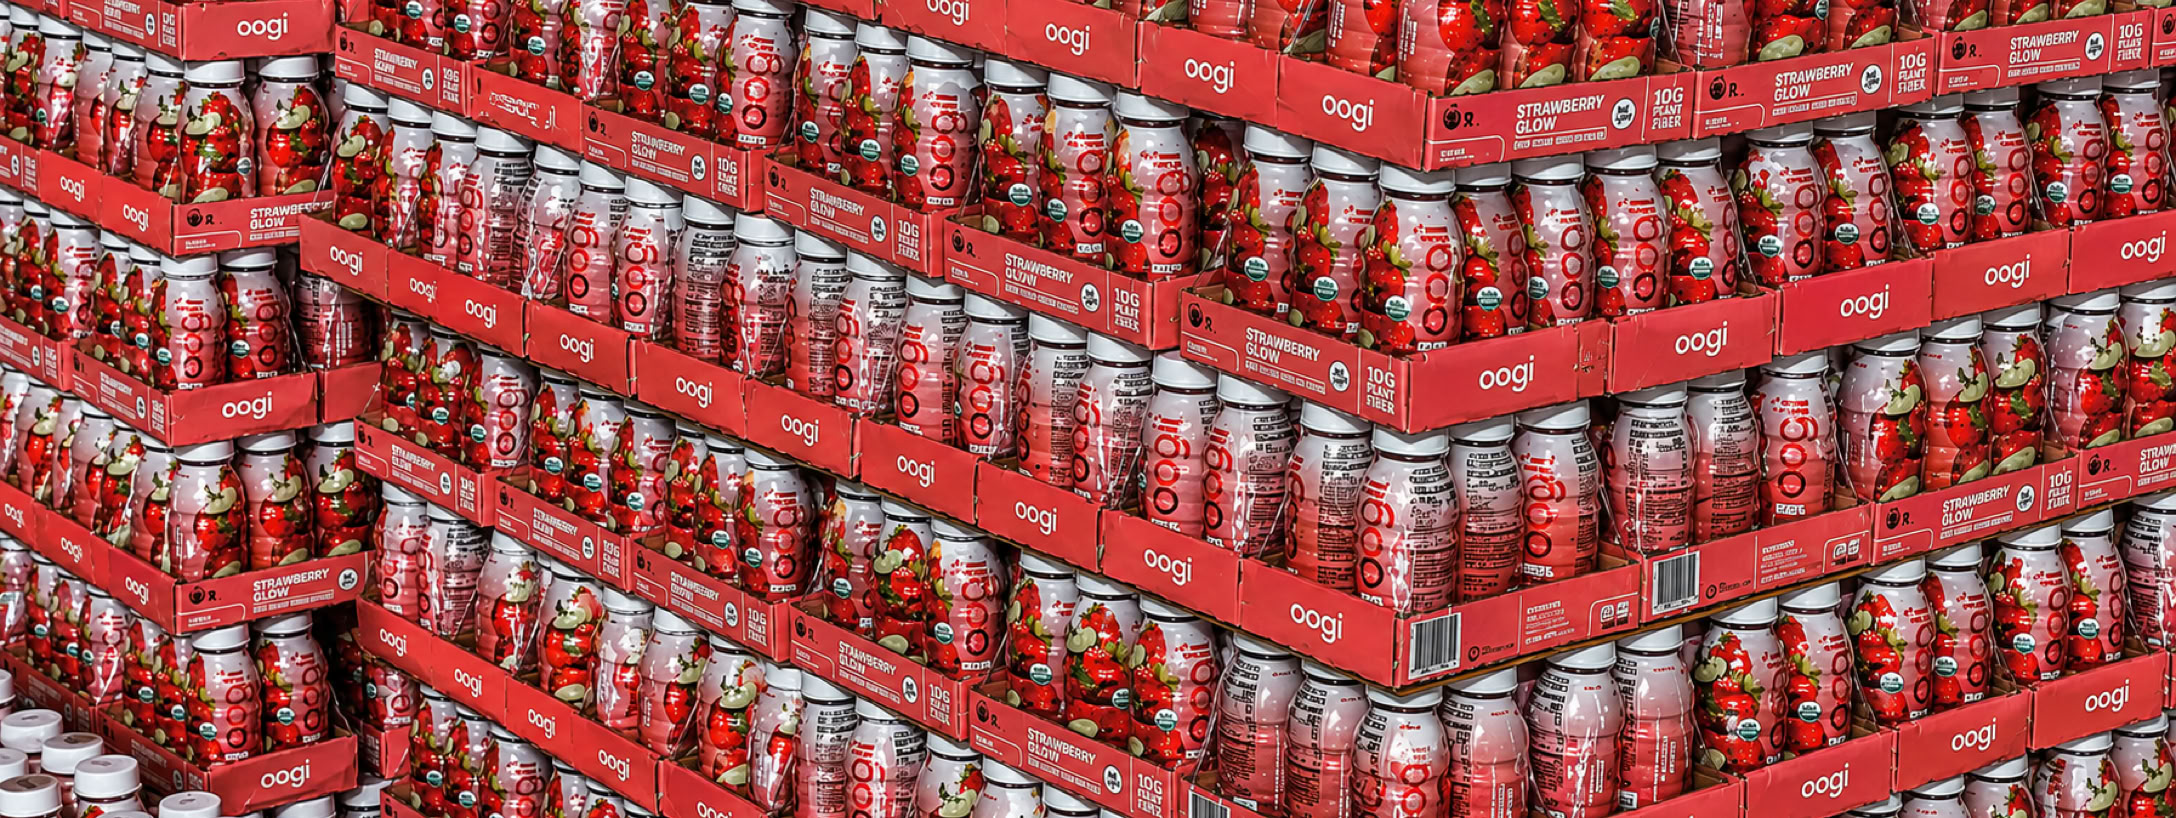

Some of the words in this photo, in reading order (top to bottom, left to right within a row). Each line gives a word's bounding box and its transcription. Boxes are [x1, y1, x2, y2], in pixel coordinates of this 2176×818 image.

[236, 11, 289, 41] oogi
[1045, 23, 1091, 56] oogi
[2010, 30, 2080, 52] STRAWBERRY
[2119, 23, 2143, 40] 10G
[1900, 52, 1927, 71] 10G
[2009, 48, 2042, 65] GLOW
[1184, 58, 1235, 94] oogi
[1775, 61, 1854, 89] STRAWBERRY
[1516, 94, 1606, 120] STRAWBERRY
[1654, 87, 1684, 106] 10G
[1774, 84, 1812, 103] GLOW
[1322, 94, 1375, 132] oogi
[1515, 115, 1558, 136] GLOW
[1651, 115, 1682, 131] FIBER
[717, 157, 738, 174] 10G
[59, 175, 85, 203] oogi
[122, 203, 150, 230] oogi
[898, 219, 920, 237] 10G
[329, 245, 363, 276] oogi
[2120, 230, 2167, 263] oogi
[1005, 252, 1074, 284] STRAWBERRY
[1984, 253, 2031, 289] oogi
[1115, 287, 1140, 307] 10G
[1840, 283, 1890, 320] oogi
[465, 299, 497, 329] oogi
[559, 333, 594, 363] oogi
[1245, 327, 1321, 362] STRAWBERRY
[1246, 342, 1280, 364] GLOW
[1675, 320, 1728, 357] oogi
[1366, 366, 1396, 389] 10G
[1478, 354, 1535, 392] oogi
[221, 390, 273, 420] oogi
[675, 376, 713, 409] oogi
[1366, 381, 1396, 401] PLANT
[781, 414, 819, 447] oogi
[896, 455, 935, 488] oogi
[2049, 470, 2072, 489] 10G
[1942, 484, 2011, 514] STRAWBERRY
[1015, 501, 1057, 535] oogi
[253, 568, 330, 593] STRAWBERRY
[1143, 549, 1193, 586] oogi
[1290, 603, 1343, 644] oogi
[379, 628, 407, 657] oogi
[454, 668, 483, 698] oogi
[2084, 678, 2130, 713] oogi
[527, 708, 556, 739] oogi
[1951, 717, 1997, 751] oogi
[1027, 727, 1096, 766] STRAWBERRY
[260, 758, 310, 789] oogi
[598, 749, 630, 782] oogi
[1801, 762, 1849, 799] oogi
[1137, 773, 1163, 795] 10G
